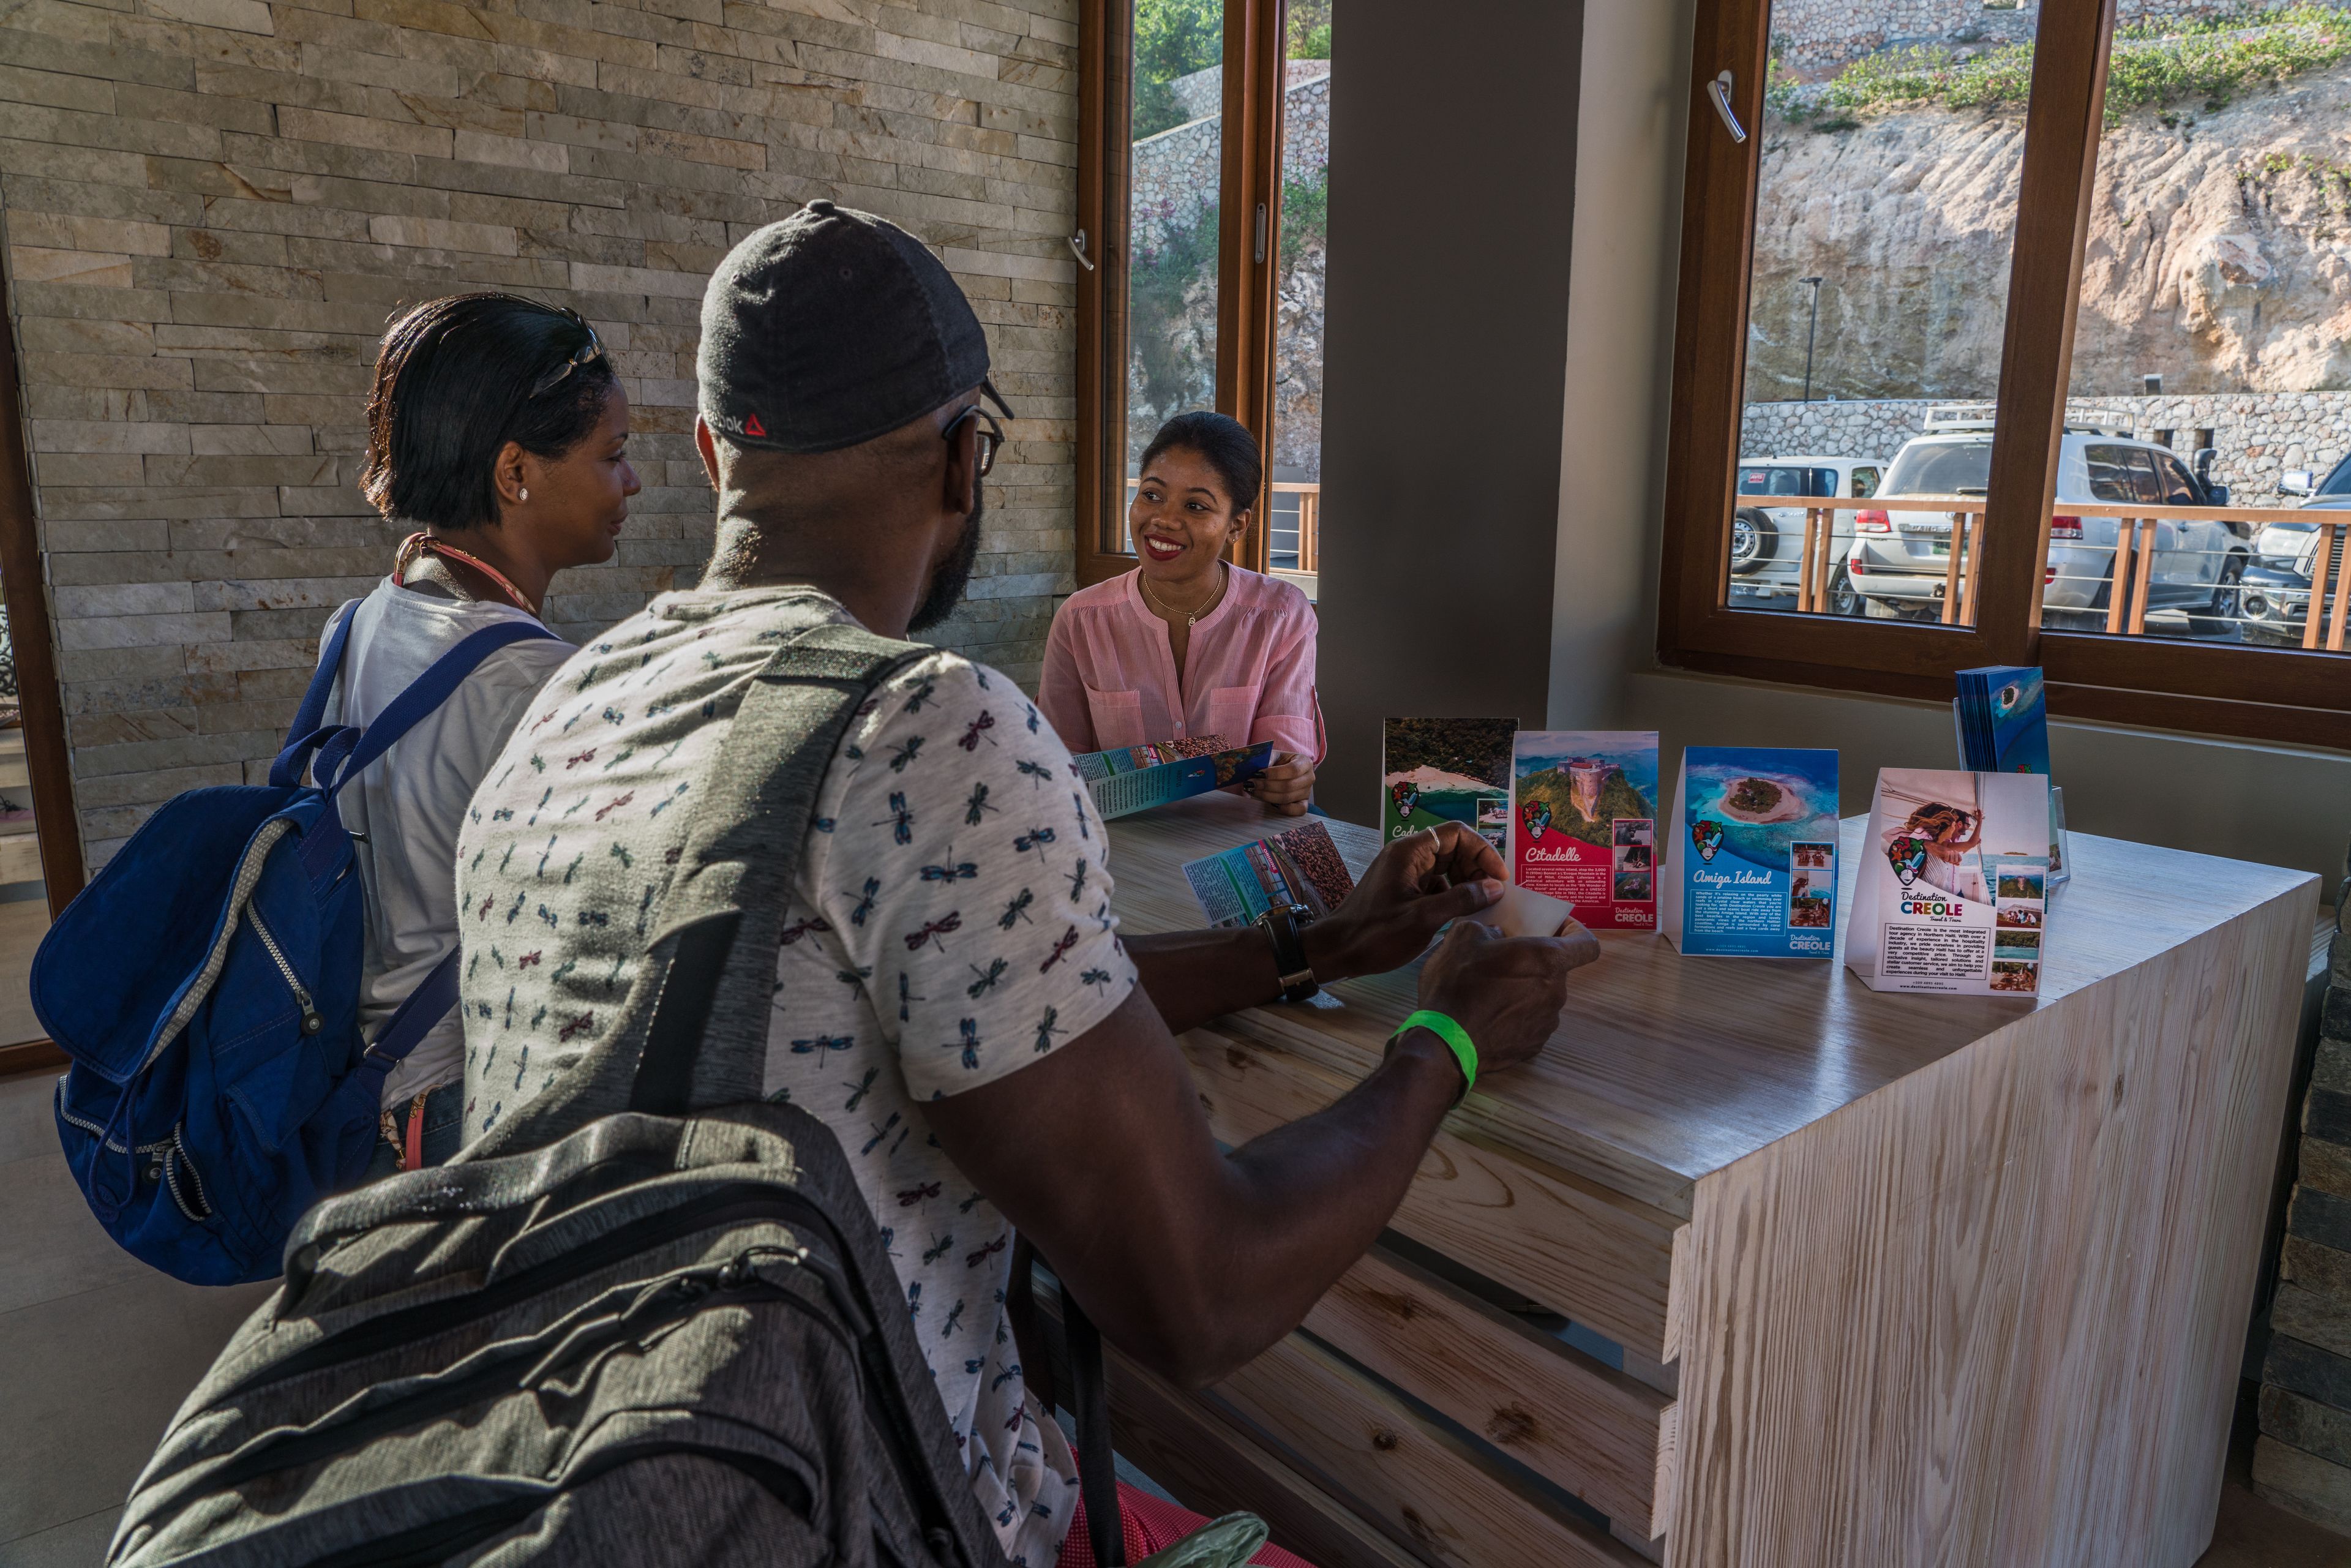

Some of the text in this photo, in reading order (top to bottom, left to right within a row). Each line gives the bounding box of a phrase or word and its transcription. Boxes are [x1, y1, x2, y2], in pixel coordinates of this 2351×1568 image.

[1263, 849, 1277, 871] ORIGINE
[1526, 847, 1581, 862] Citadelle
[1693, 870, 1772, 889] Amiga Island
[1901, 891, 1947, 901] Destination
[1901, 901, 1963, 917] CREOLE
[1615, 913, 1653, 922] CREOLE
[1790, 941, 1831, 950] CREOLE
